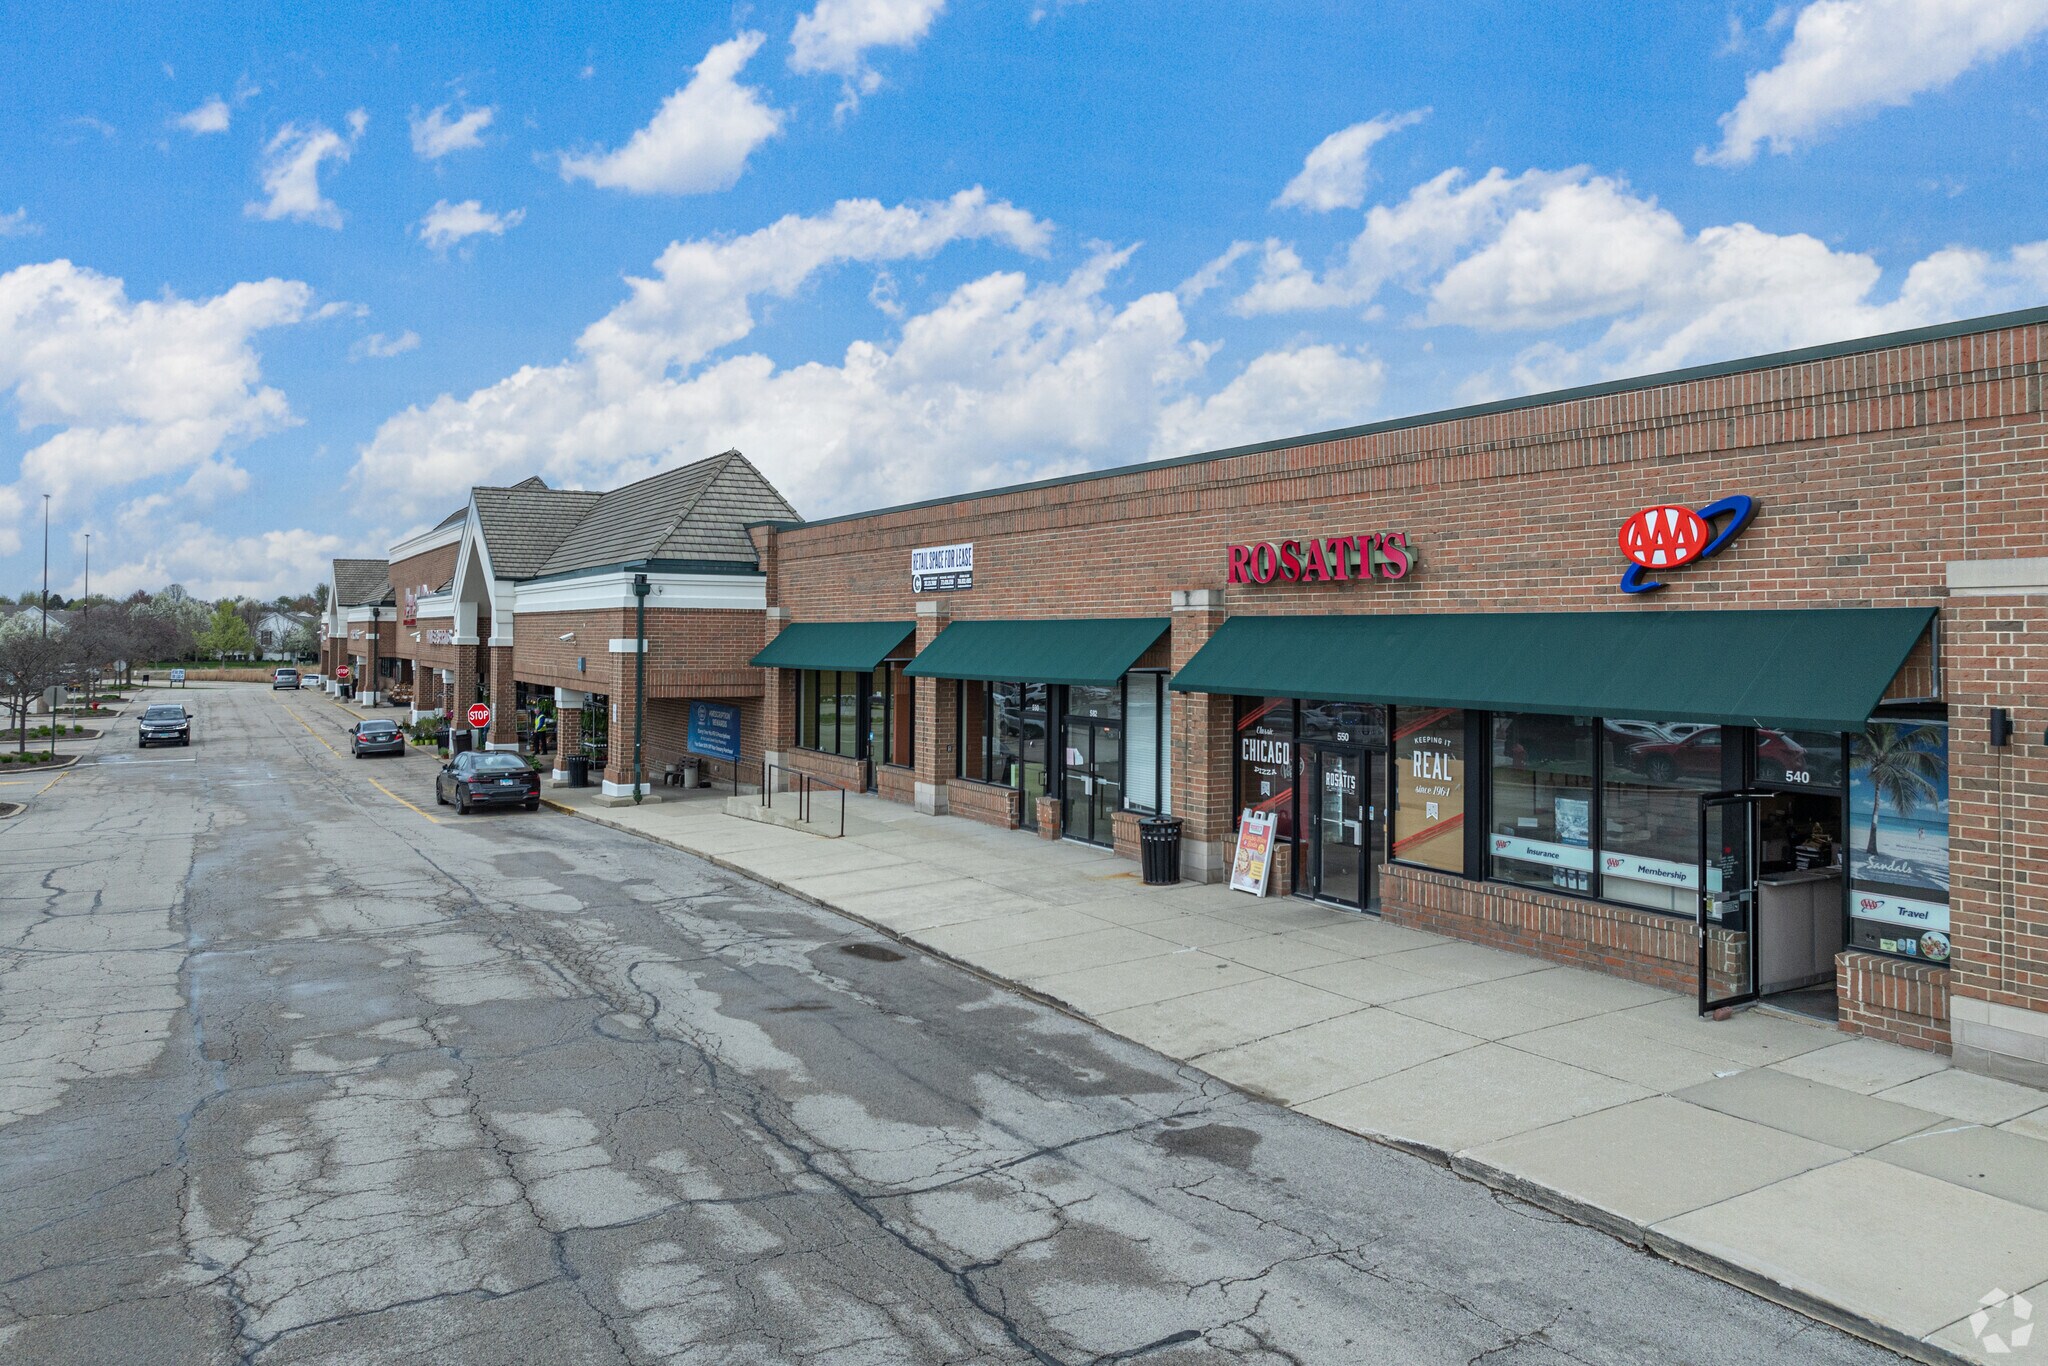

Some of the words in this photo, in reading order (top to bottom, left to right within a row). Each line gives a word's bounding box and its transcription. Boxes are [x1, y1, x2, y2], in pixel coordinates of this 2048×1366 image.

[1626, 507, 1700, 566] AAA
[913, 552, 928, 570] RETAIL
[929, 550, 944, 569] SPACE
[944, 549, 955, 568] FOR
[955, 547, 972, 568] LEASE
[1227, 532, 1410, 584] ROSATI'S
[469, 710, 489, 720] STOP
[1256, 725, 1274, 735] Classic
[1337, 732, 1350, 742] 550
[1414, 736, 1442, 745] KEEPING
[1444, 739, 1451, 747] IT
[1242, 738, 1290, 765] CHICAGO
[1254, 765, 1277, 776] PIZZA
[1413, 750, 1452, 781] REAL
[1325, 772, 1356, 790] ROSATI'S
[1785, 770, 1810, 784] 540
[1415, 785, 1432, 795] since
[1432, 786, 1450, 797] 1964
[1526, 847, 1560, 859] Insurance
[1866, 855, 1913, 874] Sandals
[1638, 865, 1687, 882] Membership
[1861, 899, 1878, 910] AAA
[1897, 906, 1929, 920] Travel
